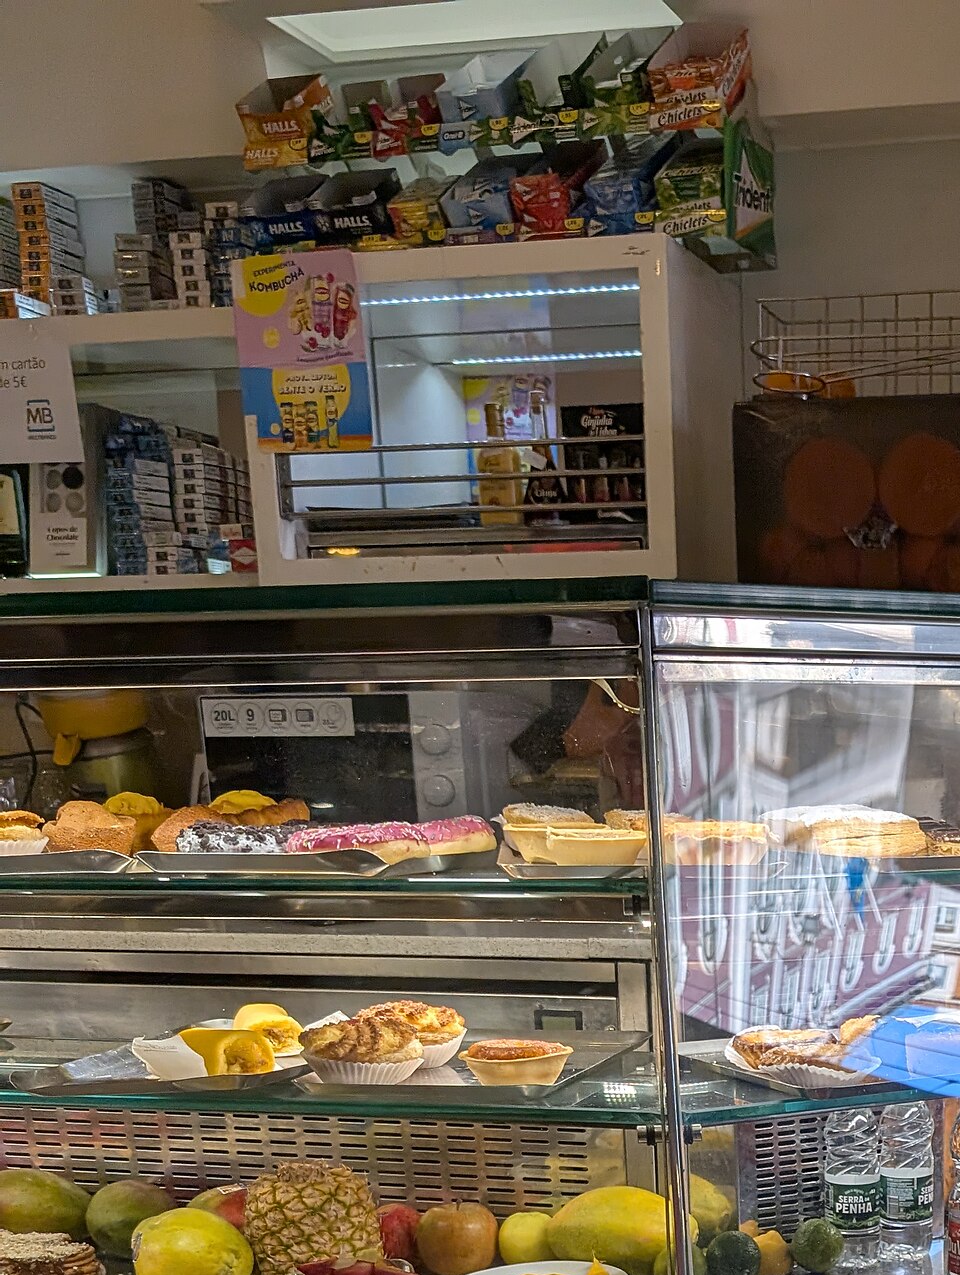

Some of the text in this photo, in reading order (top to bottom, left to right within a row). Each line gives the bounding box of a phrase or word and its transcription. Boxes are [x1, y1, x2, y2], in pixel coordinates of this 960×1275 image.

[658, 107, 702, 127] Chiclets
[263, 121, 300, 134] HALLS
[246, 149, 279, 160] HALLS
[269, 221, 304, 234] HALLS
[335, 215, 373, 228] HALLS
[663, 215, 709, 235] Chiclets
[253, 260, 297, 278] EXPERIMENTA
[249, 267, 305, 293] KOMBUCHA
[11, 357, 46, 370] cartão
[13, 376, 28, 389] 5€
[26, 407, 54, 425] MB
[214, 709, 236, 723] 20L
[246, 708, 255, 722] 9
[838, 1195, 864, 1204] SERRA
[835, 1202, 873, 1214] PENHA
